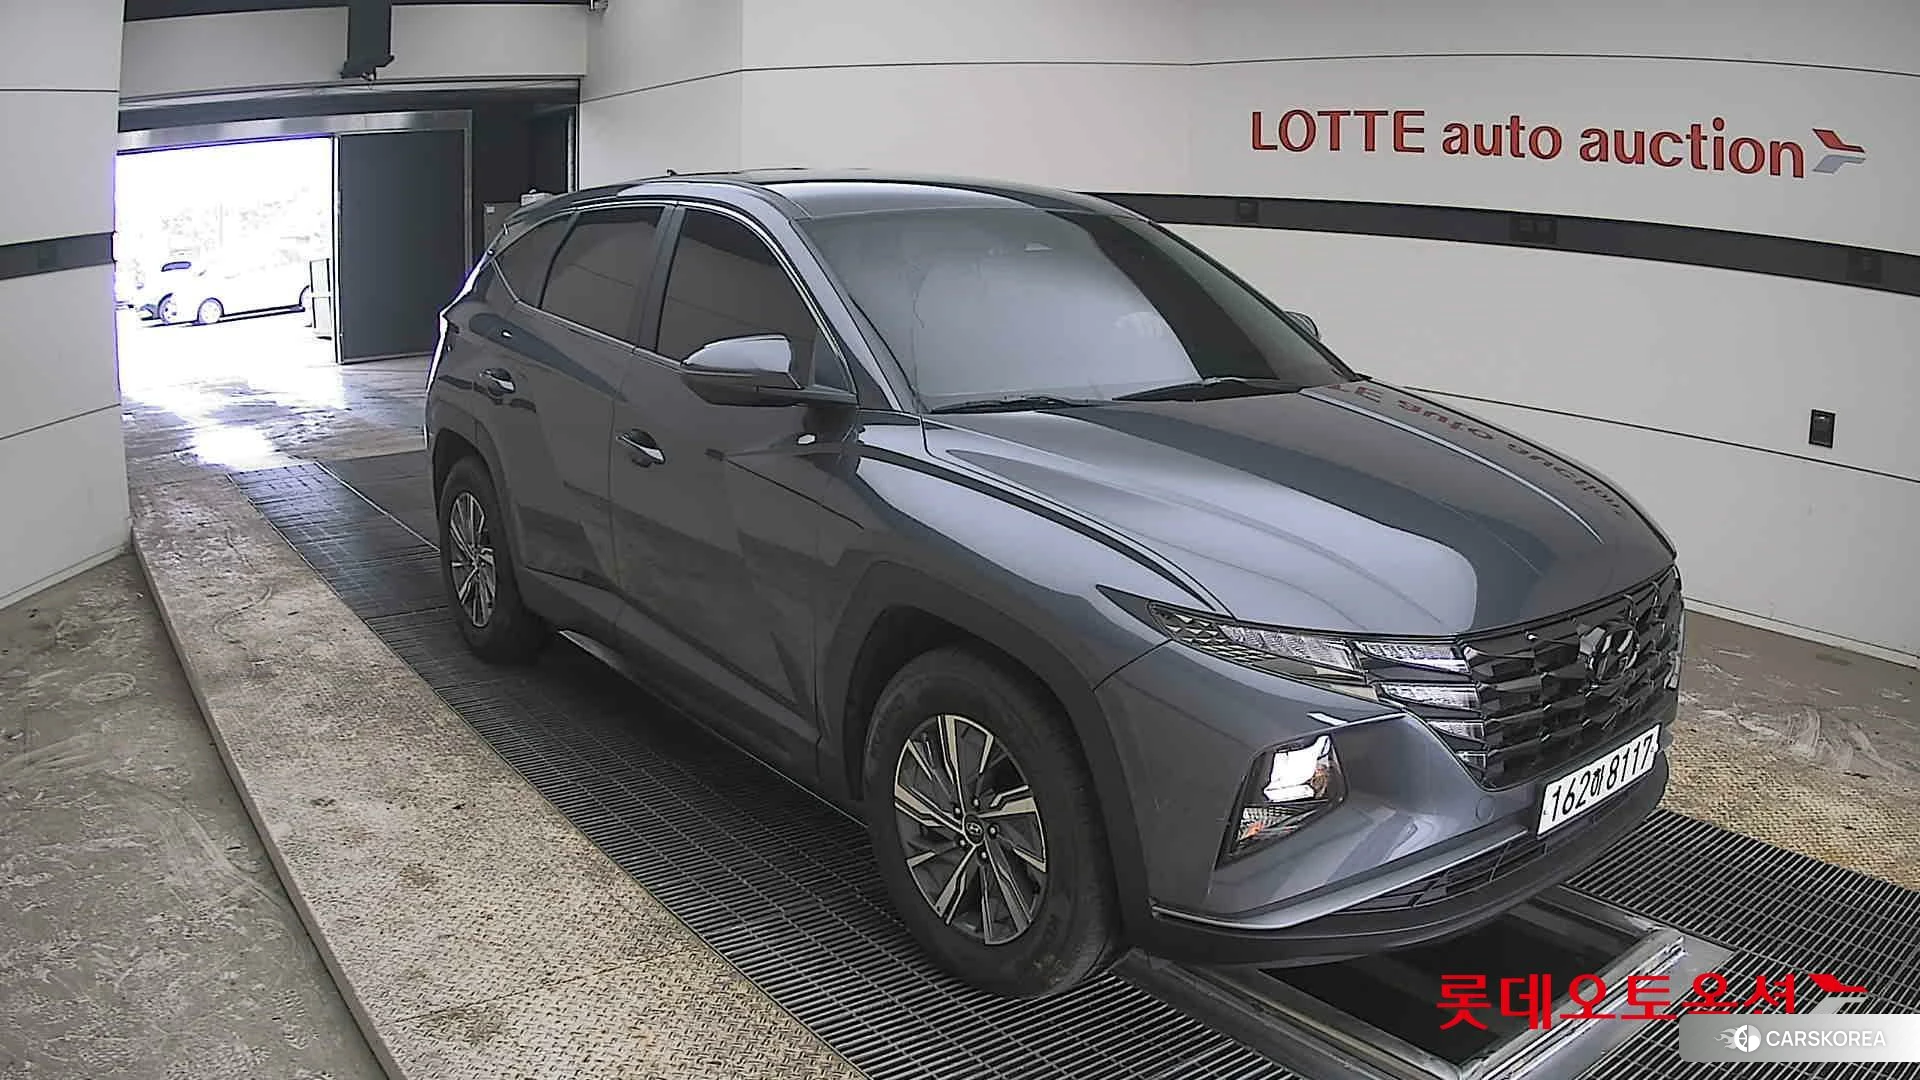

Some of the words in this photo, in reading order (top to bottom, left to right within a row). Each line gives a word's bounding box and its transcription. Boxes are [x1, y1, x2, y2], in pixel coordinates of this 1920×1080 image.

[1252, 109, 1425, 153] LOTTE
[1442, 116, 1562, 160] auto
[1580, 117, 1805, 178] auction
